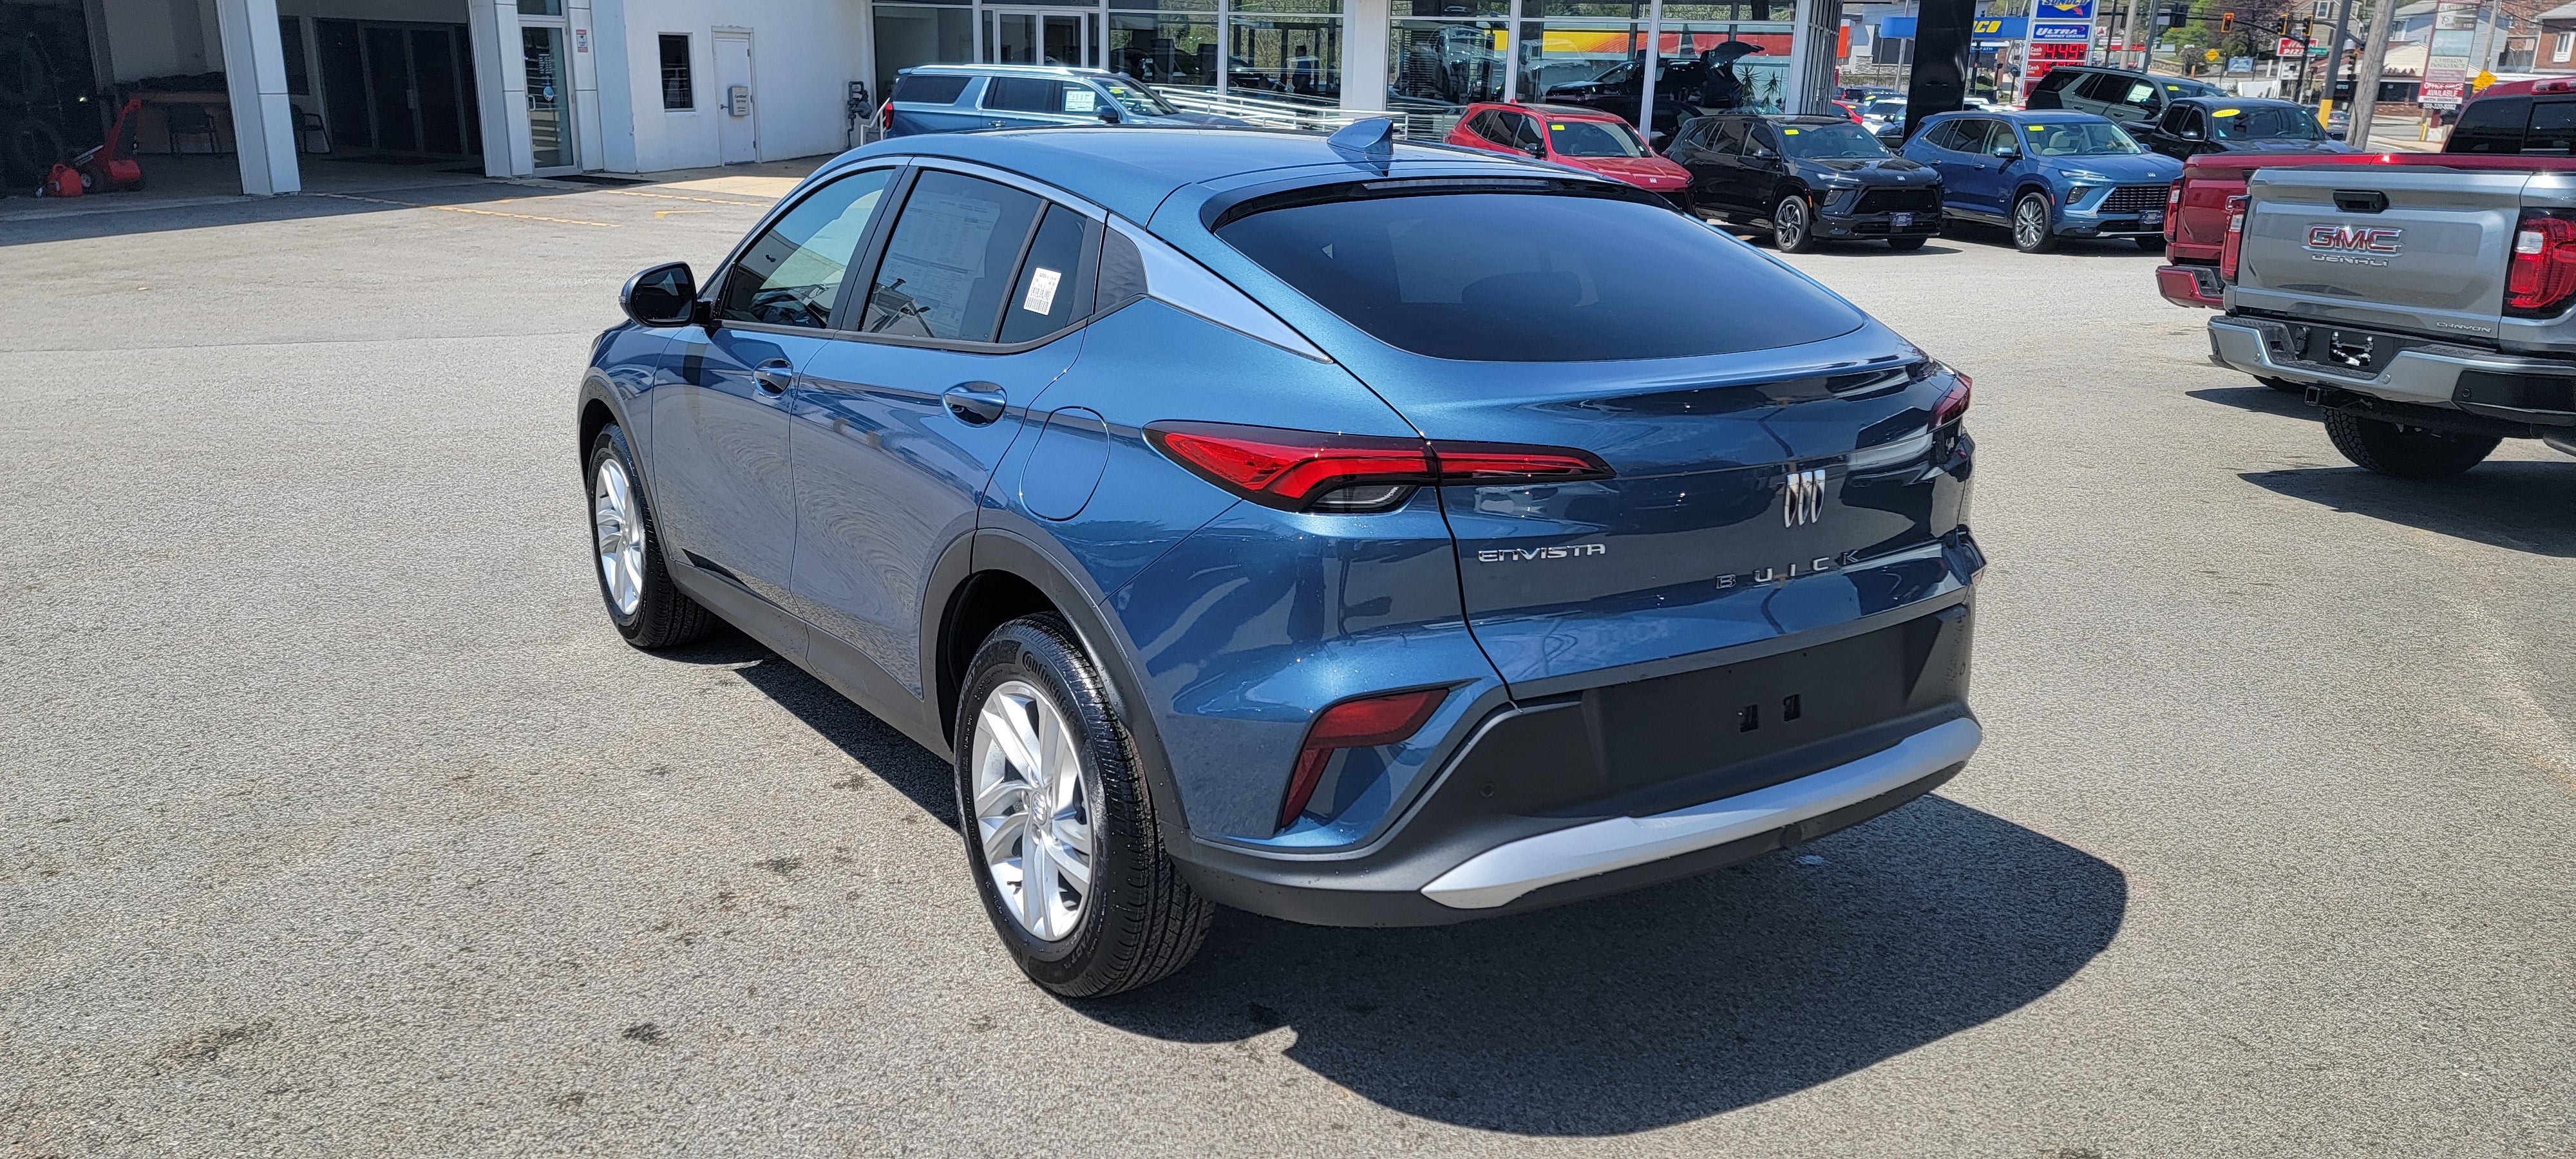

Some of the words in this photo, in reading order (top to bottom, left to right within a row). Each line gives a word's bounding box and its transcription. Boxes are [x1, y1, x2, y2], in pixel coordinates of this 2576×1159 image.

[2309, 225, 2403, 252] GMC
[2312, 254, 2389, 267] DENALI
[2436, 322, 2492, 333] CANYON
[1478, 543, 1606, 562] ENVISTA
[1716, 550, 1859, 589] BUICK
